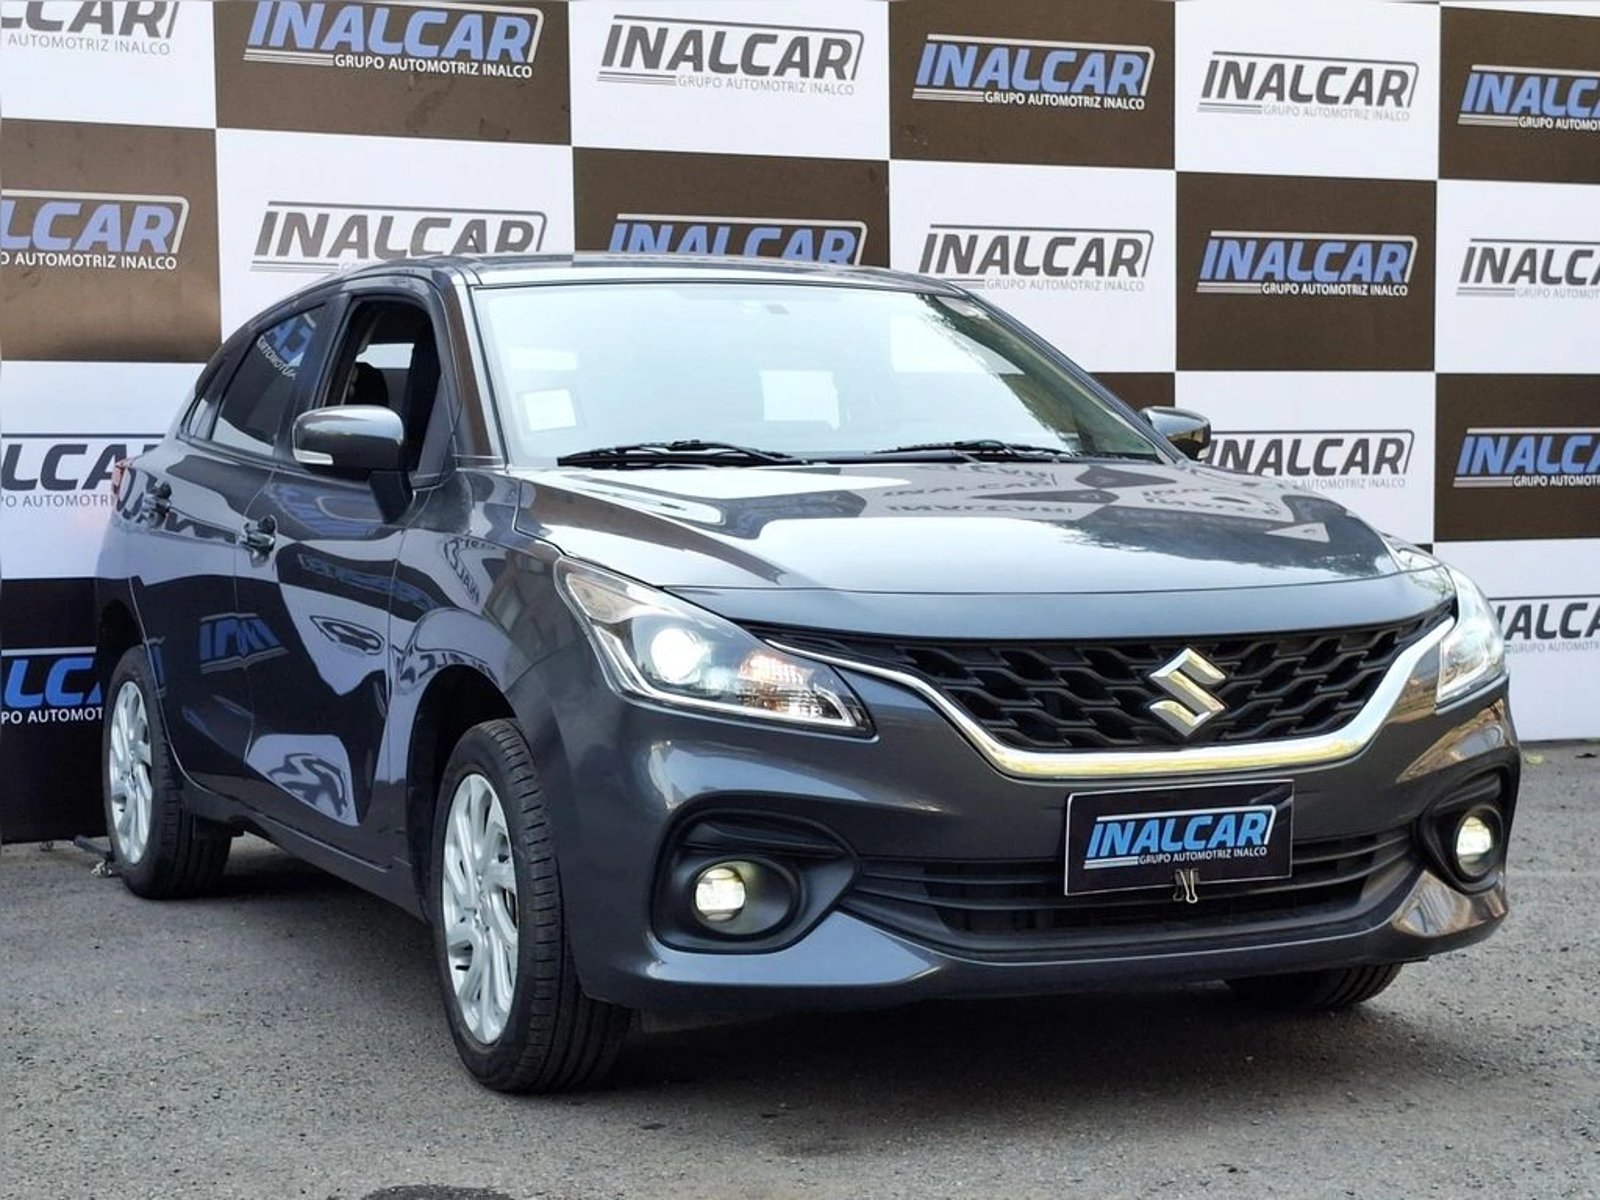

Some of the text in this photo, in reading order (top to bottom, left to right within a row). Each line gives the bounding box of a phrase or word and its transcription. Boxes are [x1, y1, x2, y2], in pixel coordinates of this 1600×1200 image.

[247, 1, 531, 62] INALCAR
[8, 34, 171, 56] AUTOMOTRIZ INALCO
[601, 24, 853, 80] INALCAR
[335, 54, 532, 79] GRUPO AUTOMOTRIZ INALCO
[915, 43, 1145, 96] INALCAR
[678, 74, 855, 96] GRUPO AUTOMOTRIZ INALCO
[1201, 60, 1409, 107] INALCAR
[985, 91, 1145, 111] GRUPO AUTOMOTRIZ INALCO
[1460, 72, 1600, 118] INALC
[1263, 105, 1410, 122] GRUPO AUTOMOTRIZ INALCO
[1518, 116, 1554, 129] GRUPO
[254, 211, 535, 260] INALCAR
[15, 253, 117, 268] AUTOMOTRIZ
[120, 256, 178, 270] INALCO
[918, 233, 1143, 278] INALCAR
[1200, 239, 1408, 283] INALCAR
[987, 279, 1145, 292] GRUPO AUTOMOTRIZ INALCO
[1262, 282, 1408, 296] GRUPO AUTOMOTRIZ INALCO
[1301, 478, 1366, 491] AUTOMOTRIZ
[1368, 478, 1406, 489] INALCO
[1513, 475, 1548, 487] GRUPO
[27, 707, 104, 724] AUTOMOT
[1086, 811, 1267, 859] INALCAR
[1138, 846, 1268, 865] GRUPO AUTOMOTRIZ INALCO
